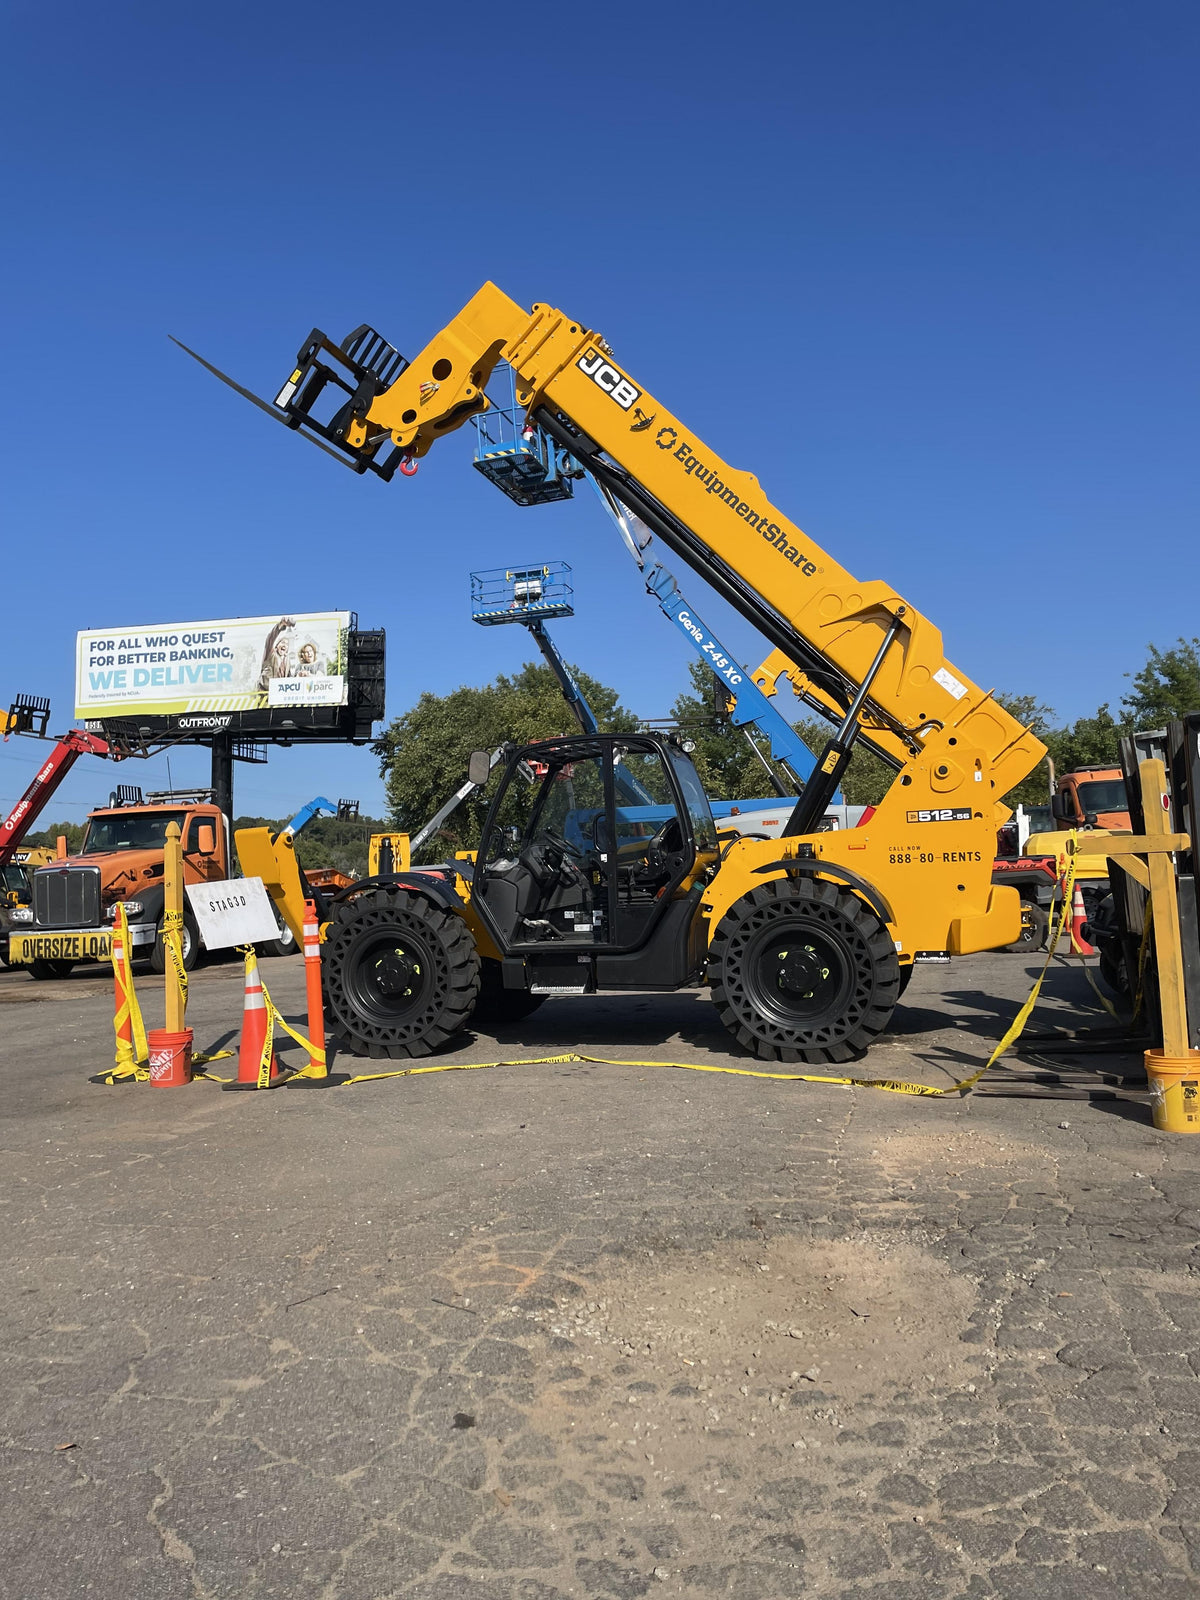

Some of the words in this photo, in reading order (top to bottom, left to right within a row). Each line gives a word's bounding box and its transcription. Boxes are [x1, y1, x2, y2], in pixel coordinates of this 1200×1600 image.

[578, 354, 639, 409] JCB
[673, 442, 817, 577] EquipmentShare
[89, 639, 115, 652] FOR
[118, 637, 142, 650] ALL
[145, 634, 179, 648] WHO
[182, 631, 226, 648] QUEST
[678, 611, 704, 644] Genie
[702, 641, 729, 668] Z-45
[723, 666, 742, 685] XC
[89, 656, 114, 667] FOR
[118, 652, 166, 665] BETTER
[169, 647, 234, 662] BANKING,
[88, 669, 127, 691] WE
[133, 663, 234, 688] DELIVER
[278, 683, 301, 692] APCU
[313, 683, 333, 693] parc
[209, 895, 246, 912] STAG3D
[22, 937, 80, 959] OVERSIZE
[82, 936, 112, 956] LOA
